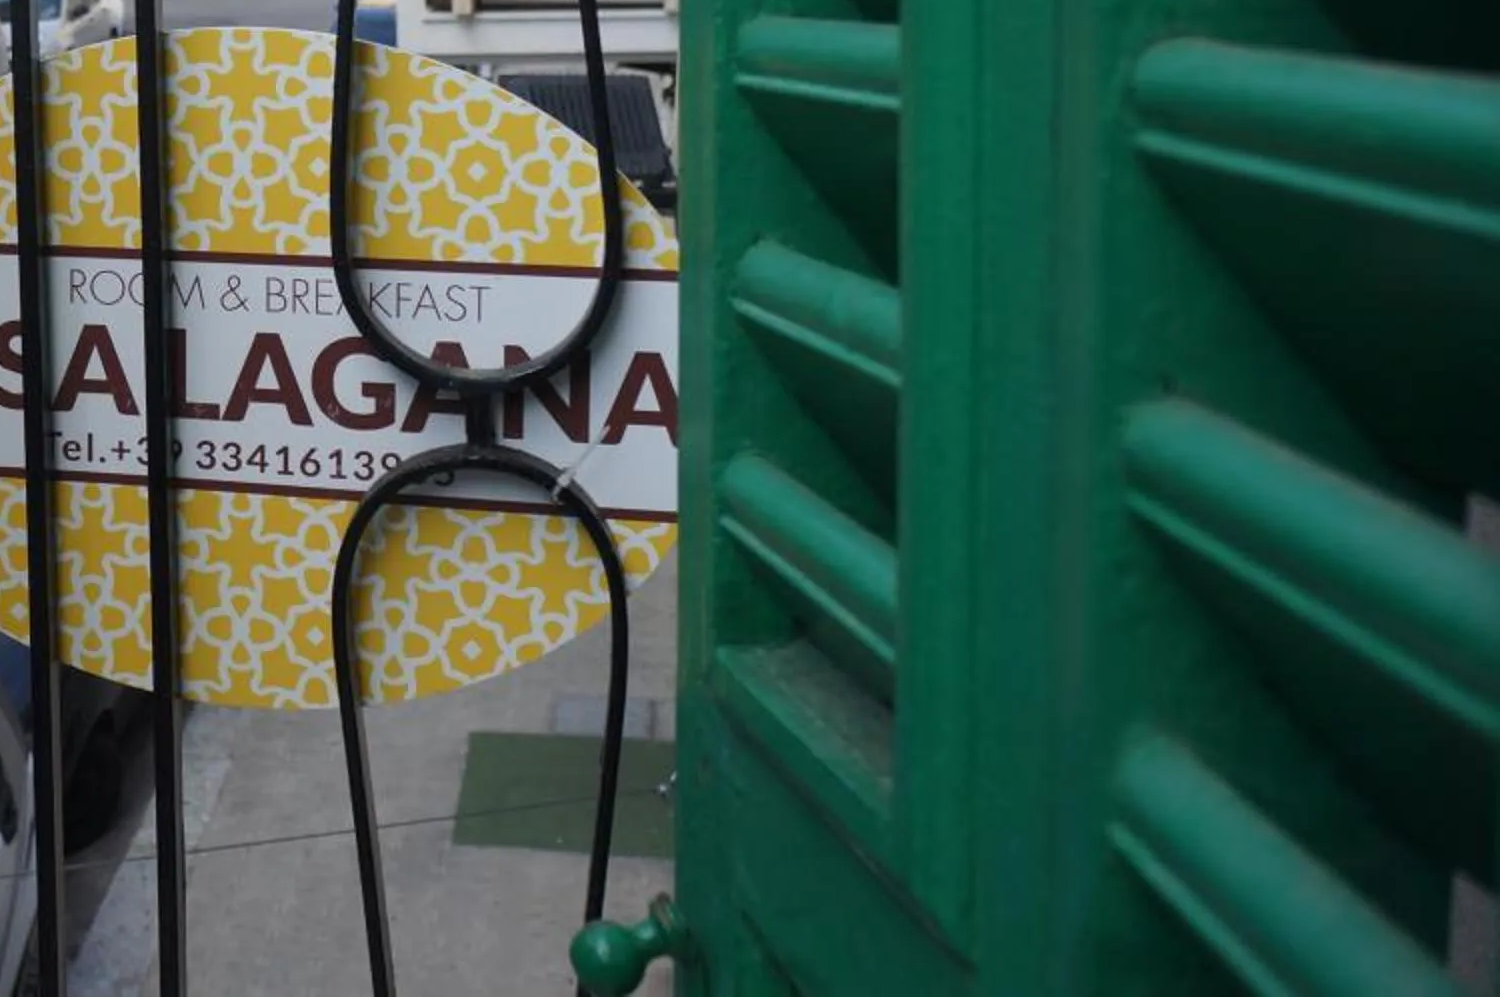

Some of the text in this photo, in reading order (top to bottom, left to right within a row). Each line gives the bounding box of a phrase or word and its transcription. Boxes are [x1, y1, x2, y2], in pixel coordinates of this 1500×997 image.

[219, 274, 251, 313] &
[265, 276, 492, 324] BREKFAST
[195, 440, 454, 486] 33416139
